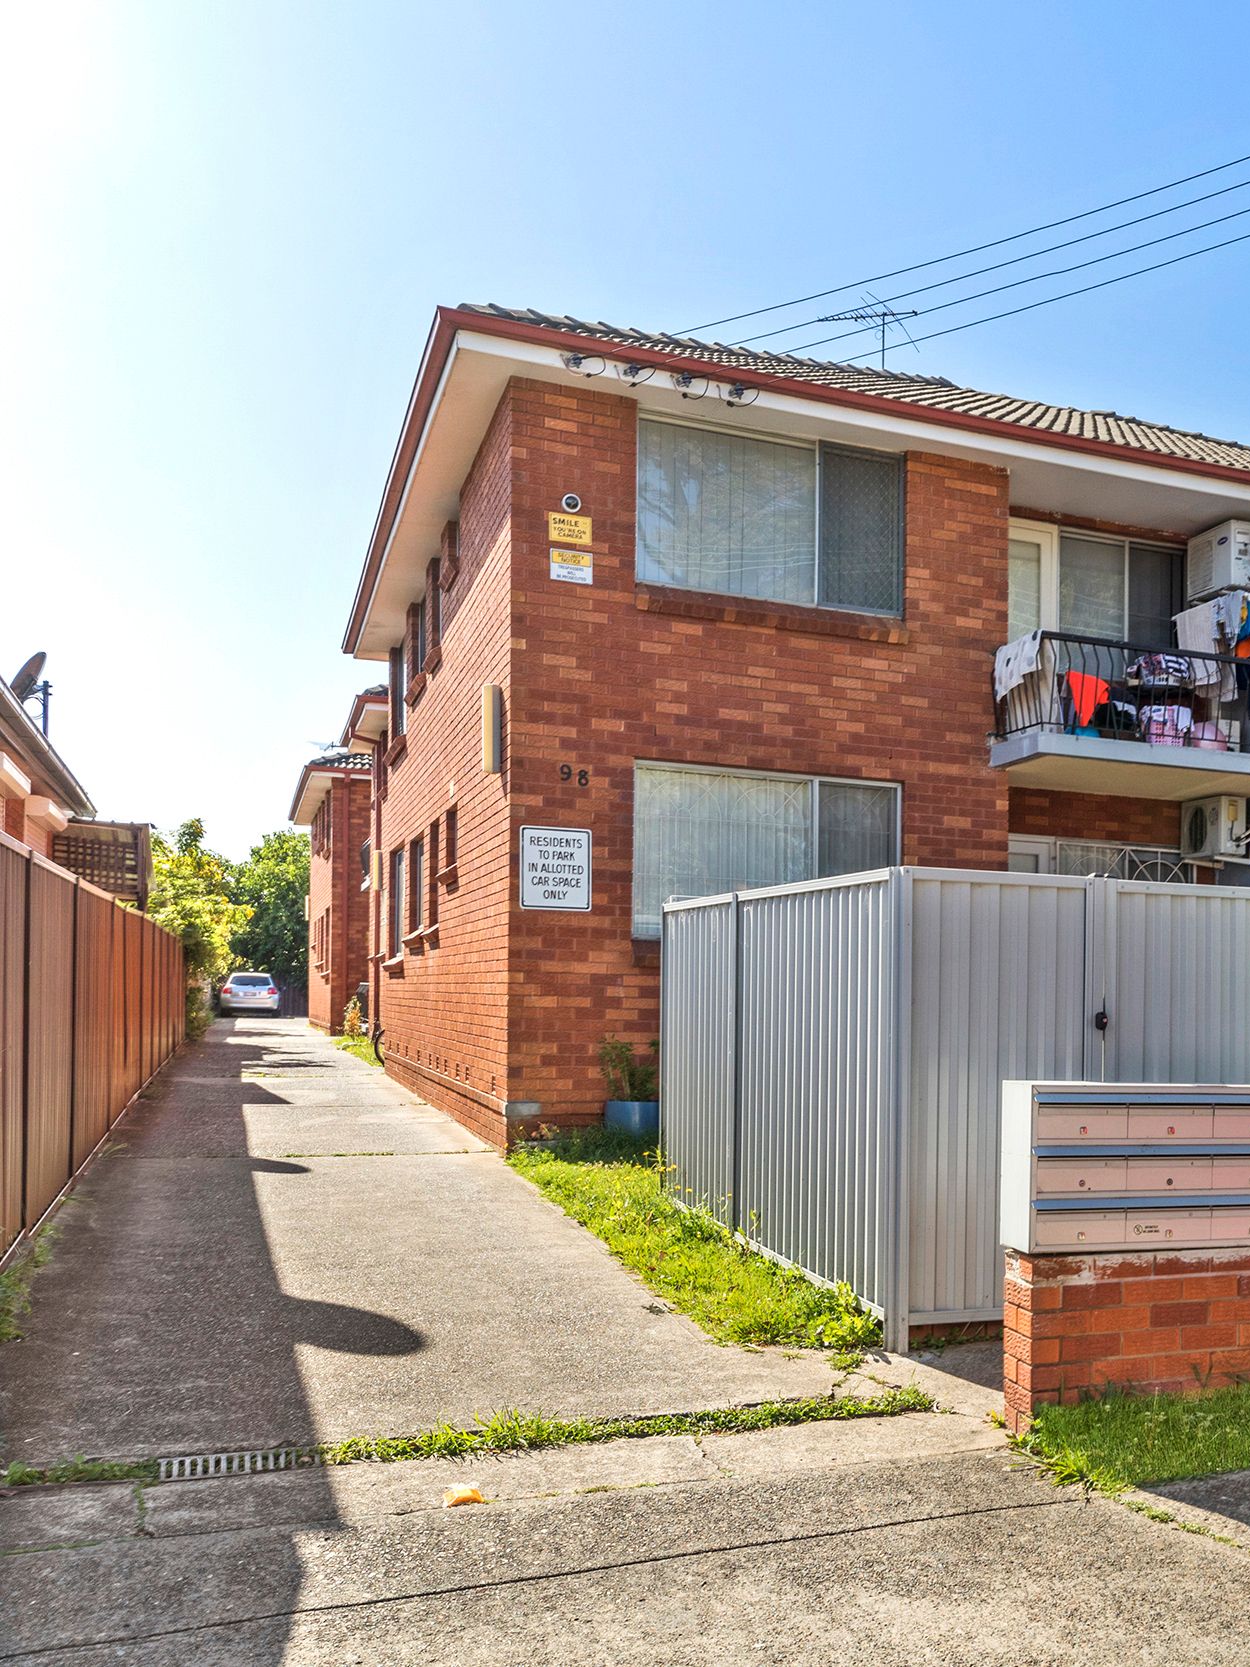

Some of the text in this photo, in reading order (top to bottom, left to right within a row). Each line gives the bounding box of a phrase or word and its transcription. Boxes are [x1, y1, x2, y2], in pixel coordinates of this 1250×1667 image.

[552, 517, 580, 528] SMILE
[557, 532, 583, 540] CAMERA
[557, 552, 584, 560] SECURITY
[560, 557, 581, 565] NOTICE
[560, 764, 589, 787] 98
[529, 836, 583, 849] RESIDENTS
[538, 849, 576, 861] TO PARK
[528, 862, 584, 875] IN ALLOTTED
[531, 875, 582, 888] CAR SPACE
[543, 889, 568, 900] ONLY
